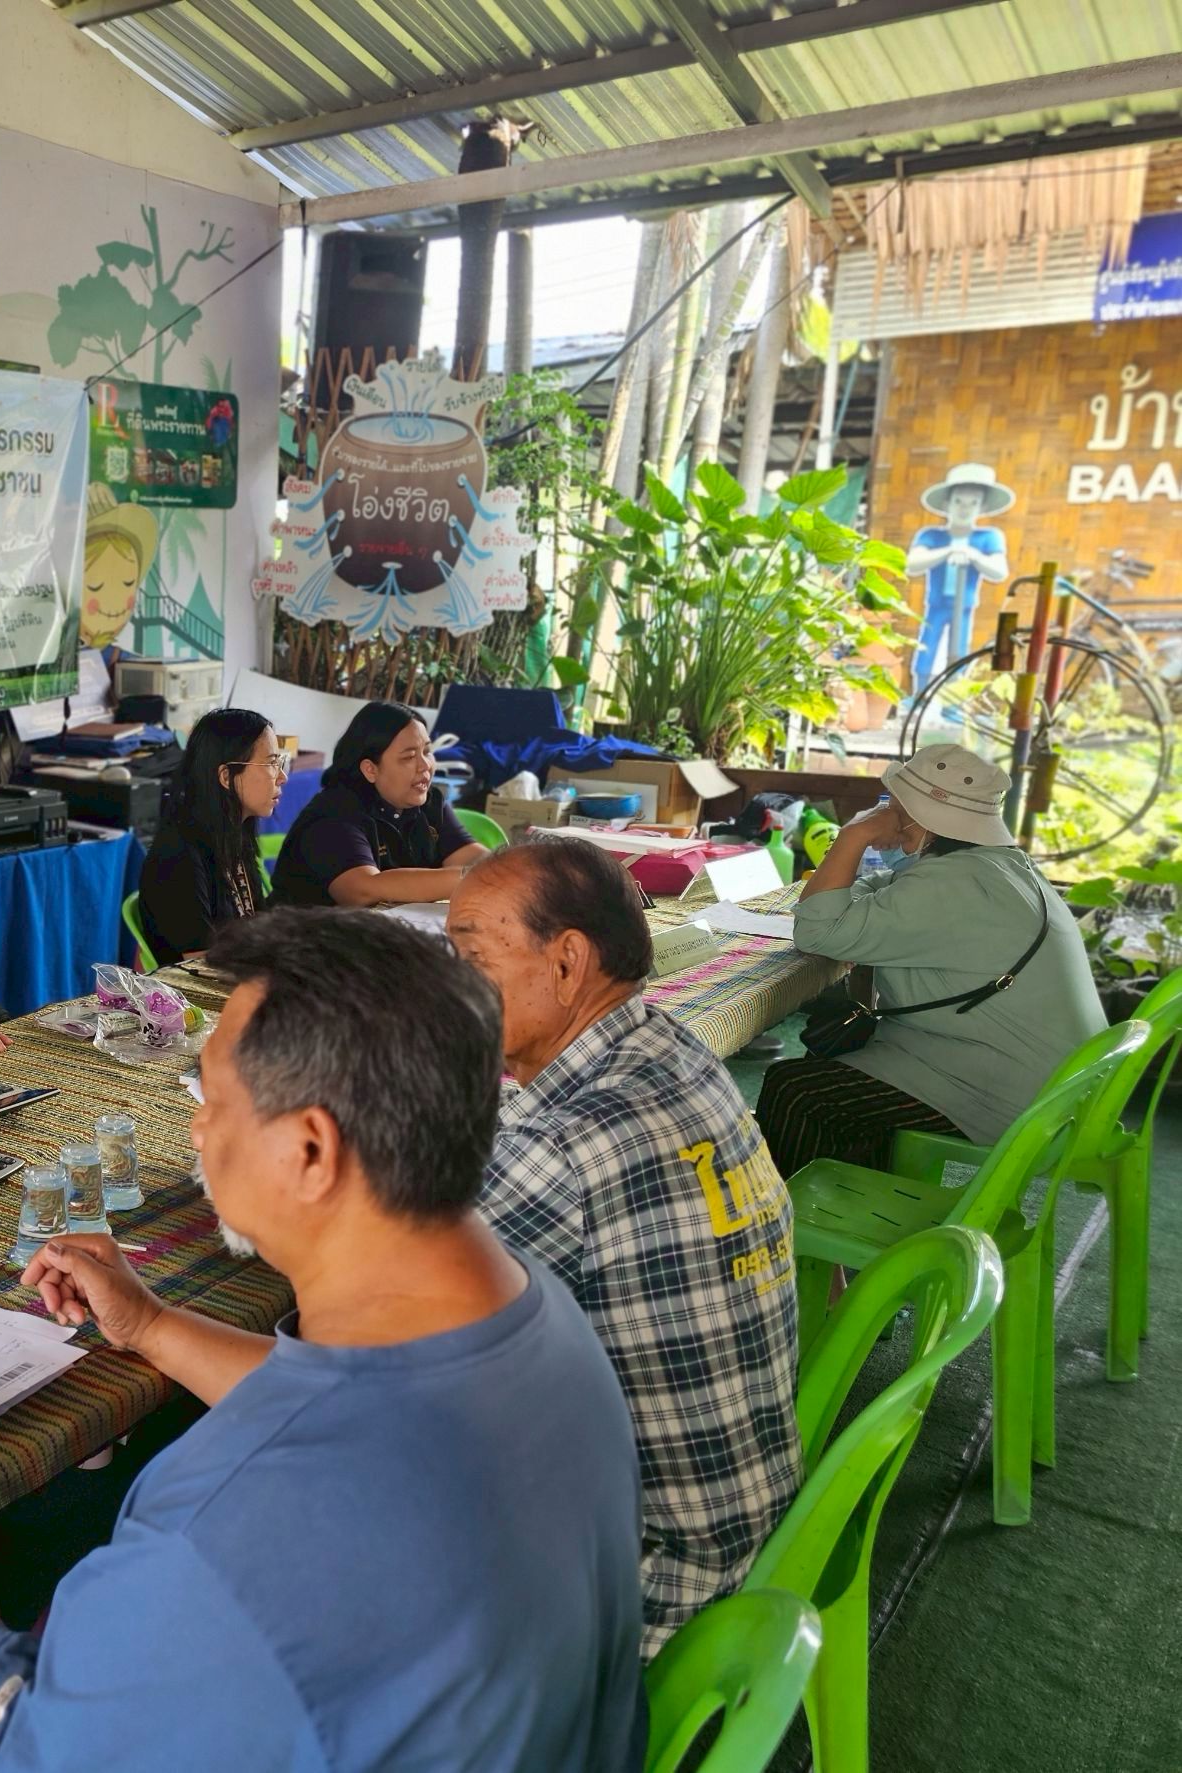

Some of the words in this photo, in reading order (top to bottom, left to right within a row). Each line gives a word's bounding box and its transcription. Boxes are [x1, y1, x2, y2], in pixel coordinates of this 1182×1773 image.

[348, 473, 450, 523] โอ่งชีวิต
[1067, 462, 1182, 504] BAA
